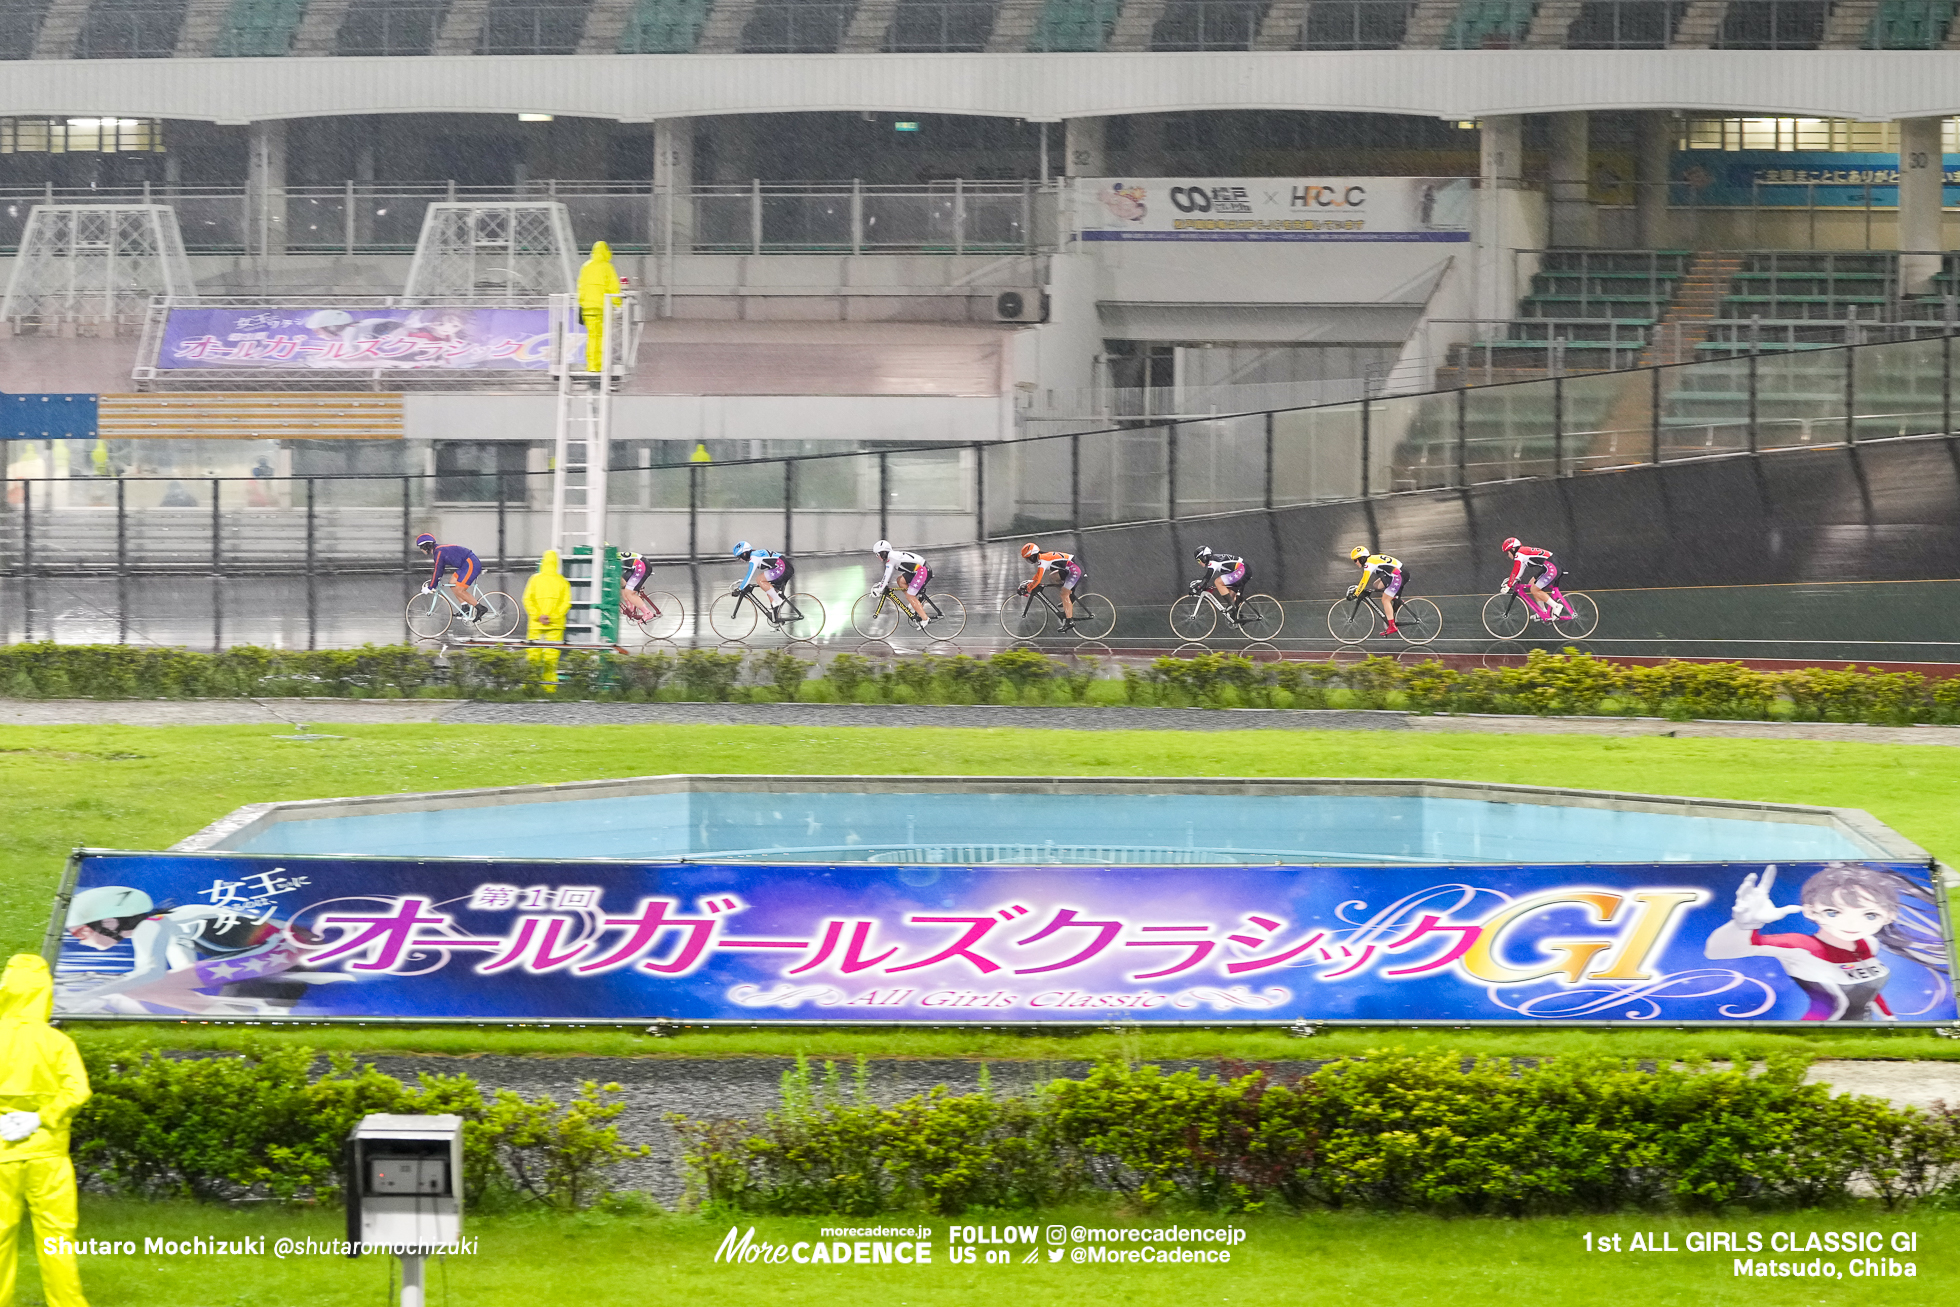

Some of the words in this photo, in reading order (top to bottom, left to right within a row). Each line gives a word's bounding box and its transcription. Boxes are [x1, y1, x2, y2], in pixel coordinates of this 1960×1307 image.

[1290, 185, 1366, 207] HPCJC
[471, 885, 600, 909] 第1回
[177, 905, 279, 940] ワタシ
[305, 896, 1484, 977] オールガールズクラシック
[1461, 890, 1700, 985] GI
[847, 989, 914, 1005] All
[921, 990, 1018, 1007] Girls
[1030, 990, 1166, 1007] Classic
